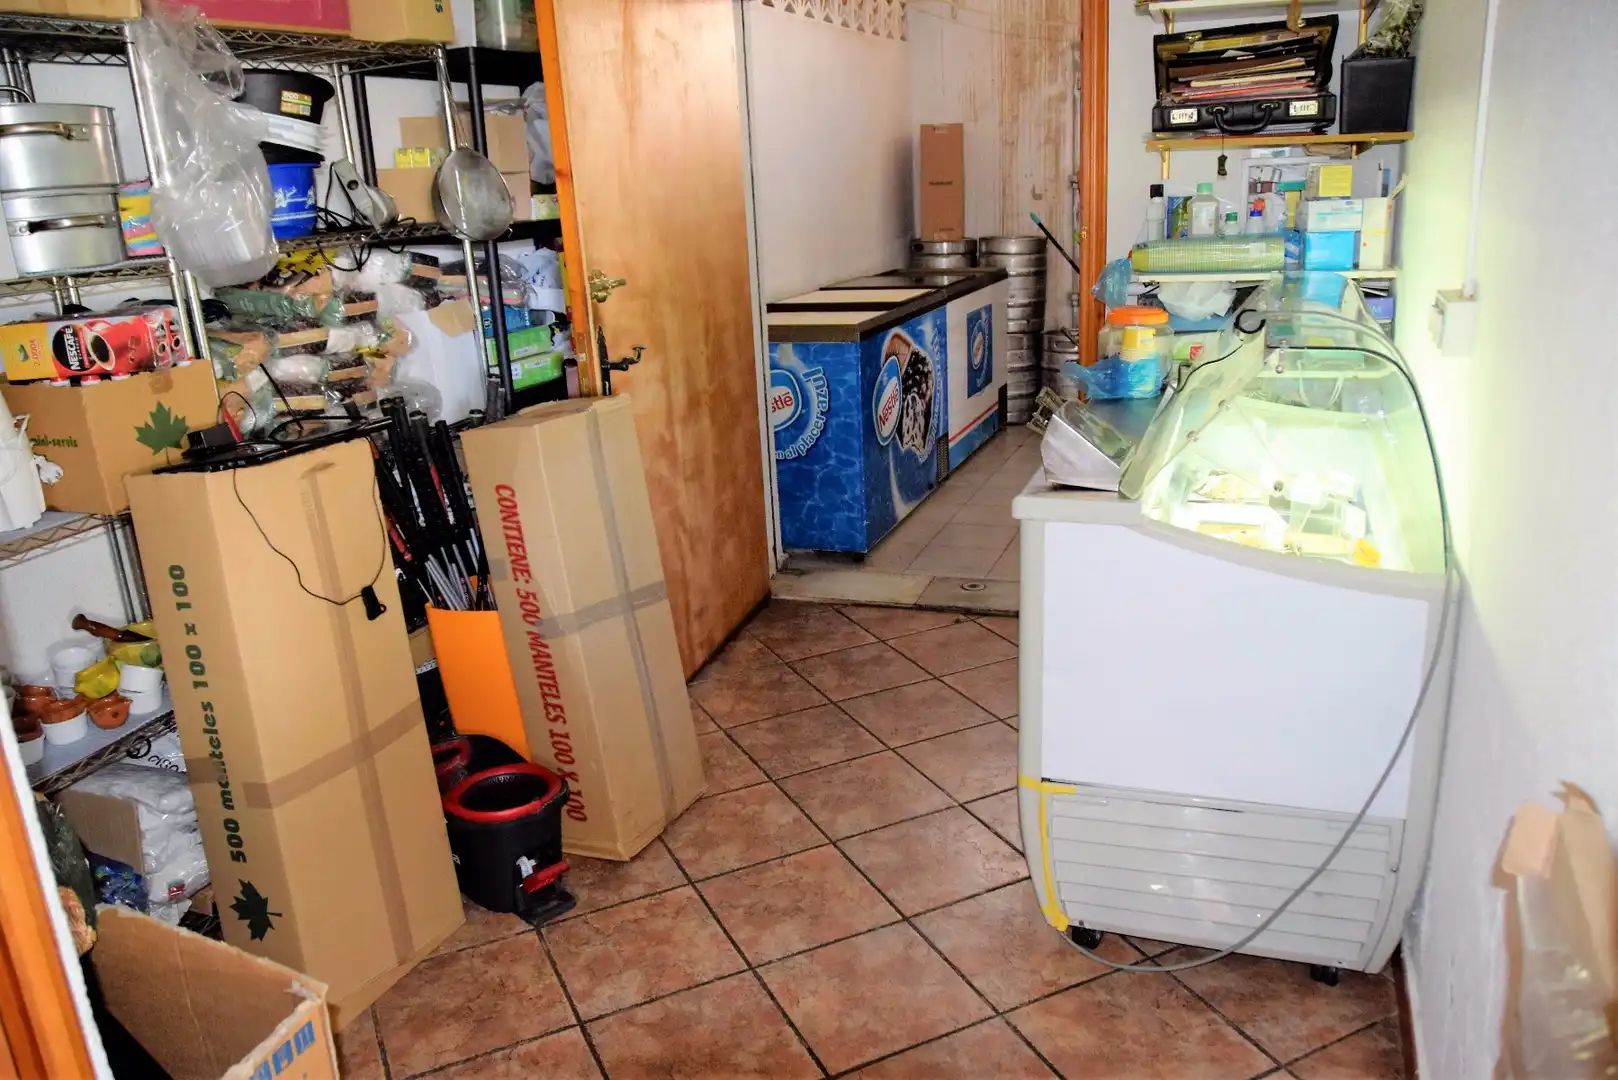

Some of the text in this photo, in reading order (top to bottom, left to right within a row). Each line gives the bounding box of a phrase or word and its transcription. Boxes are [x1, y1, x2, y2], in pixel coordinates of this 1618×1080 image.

[785, 366, 829, 459] al placer azul
[495, 483, 533, 584] CONTIENE:
[168, 564, 193, 611] 100
[516, 587, 542, 626] 500
[184, 622, 198, 636] x
[185, 643, 209, 690] 100
[526, 630, 567, 725] MANTELES
[549, 727, 576, 765] 100
[566, 788, 588, 822] 100
[223, 817, 248, 864] 500
